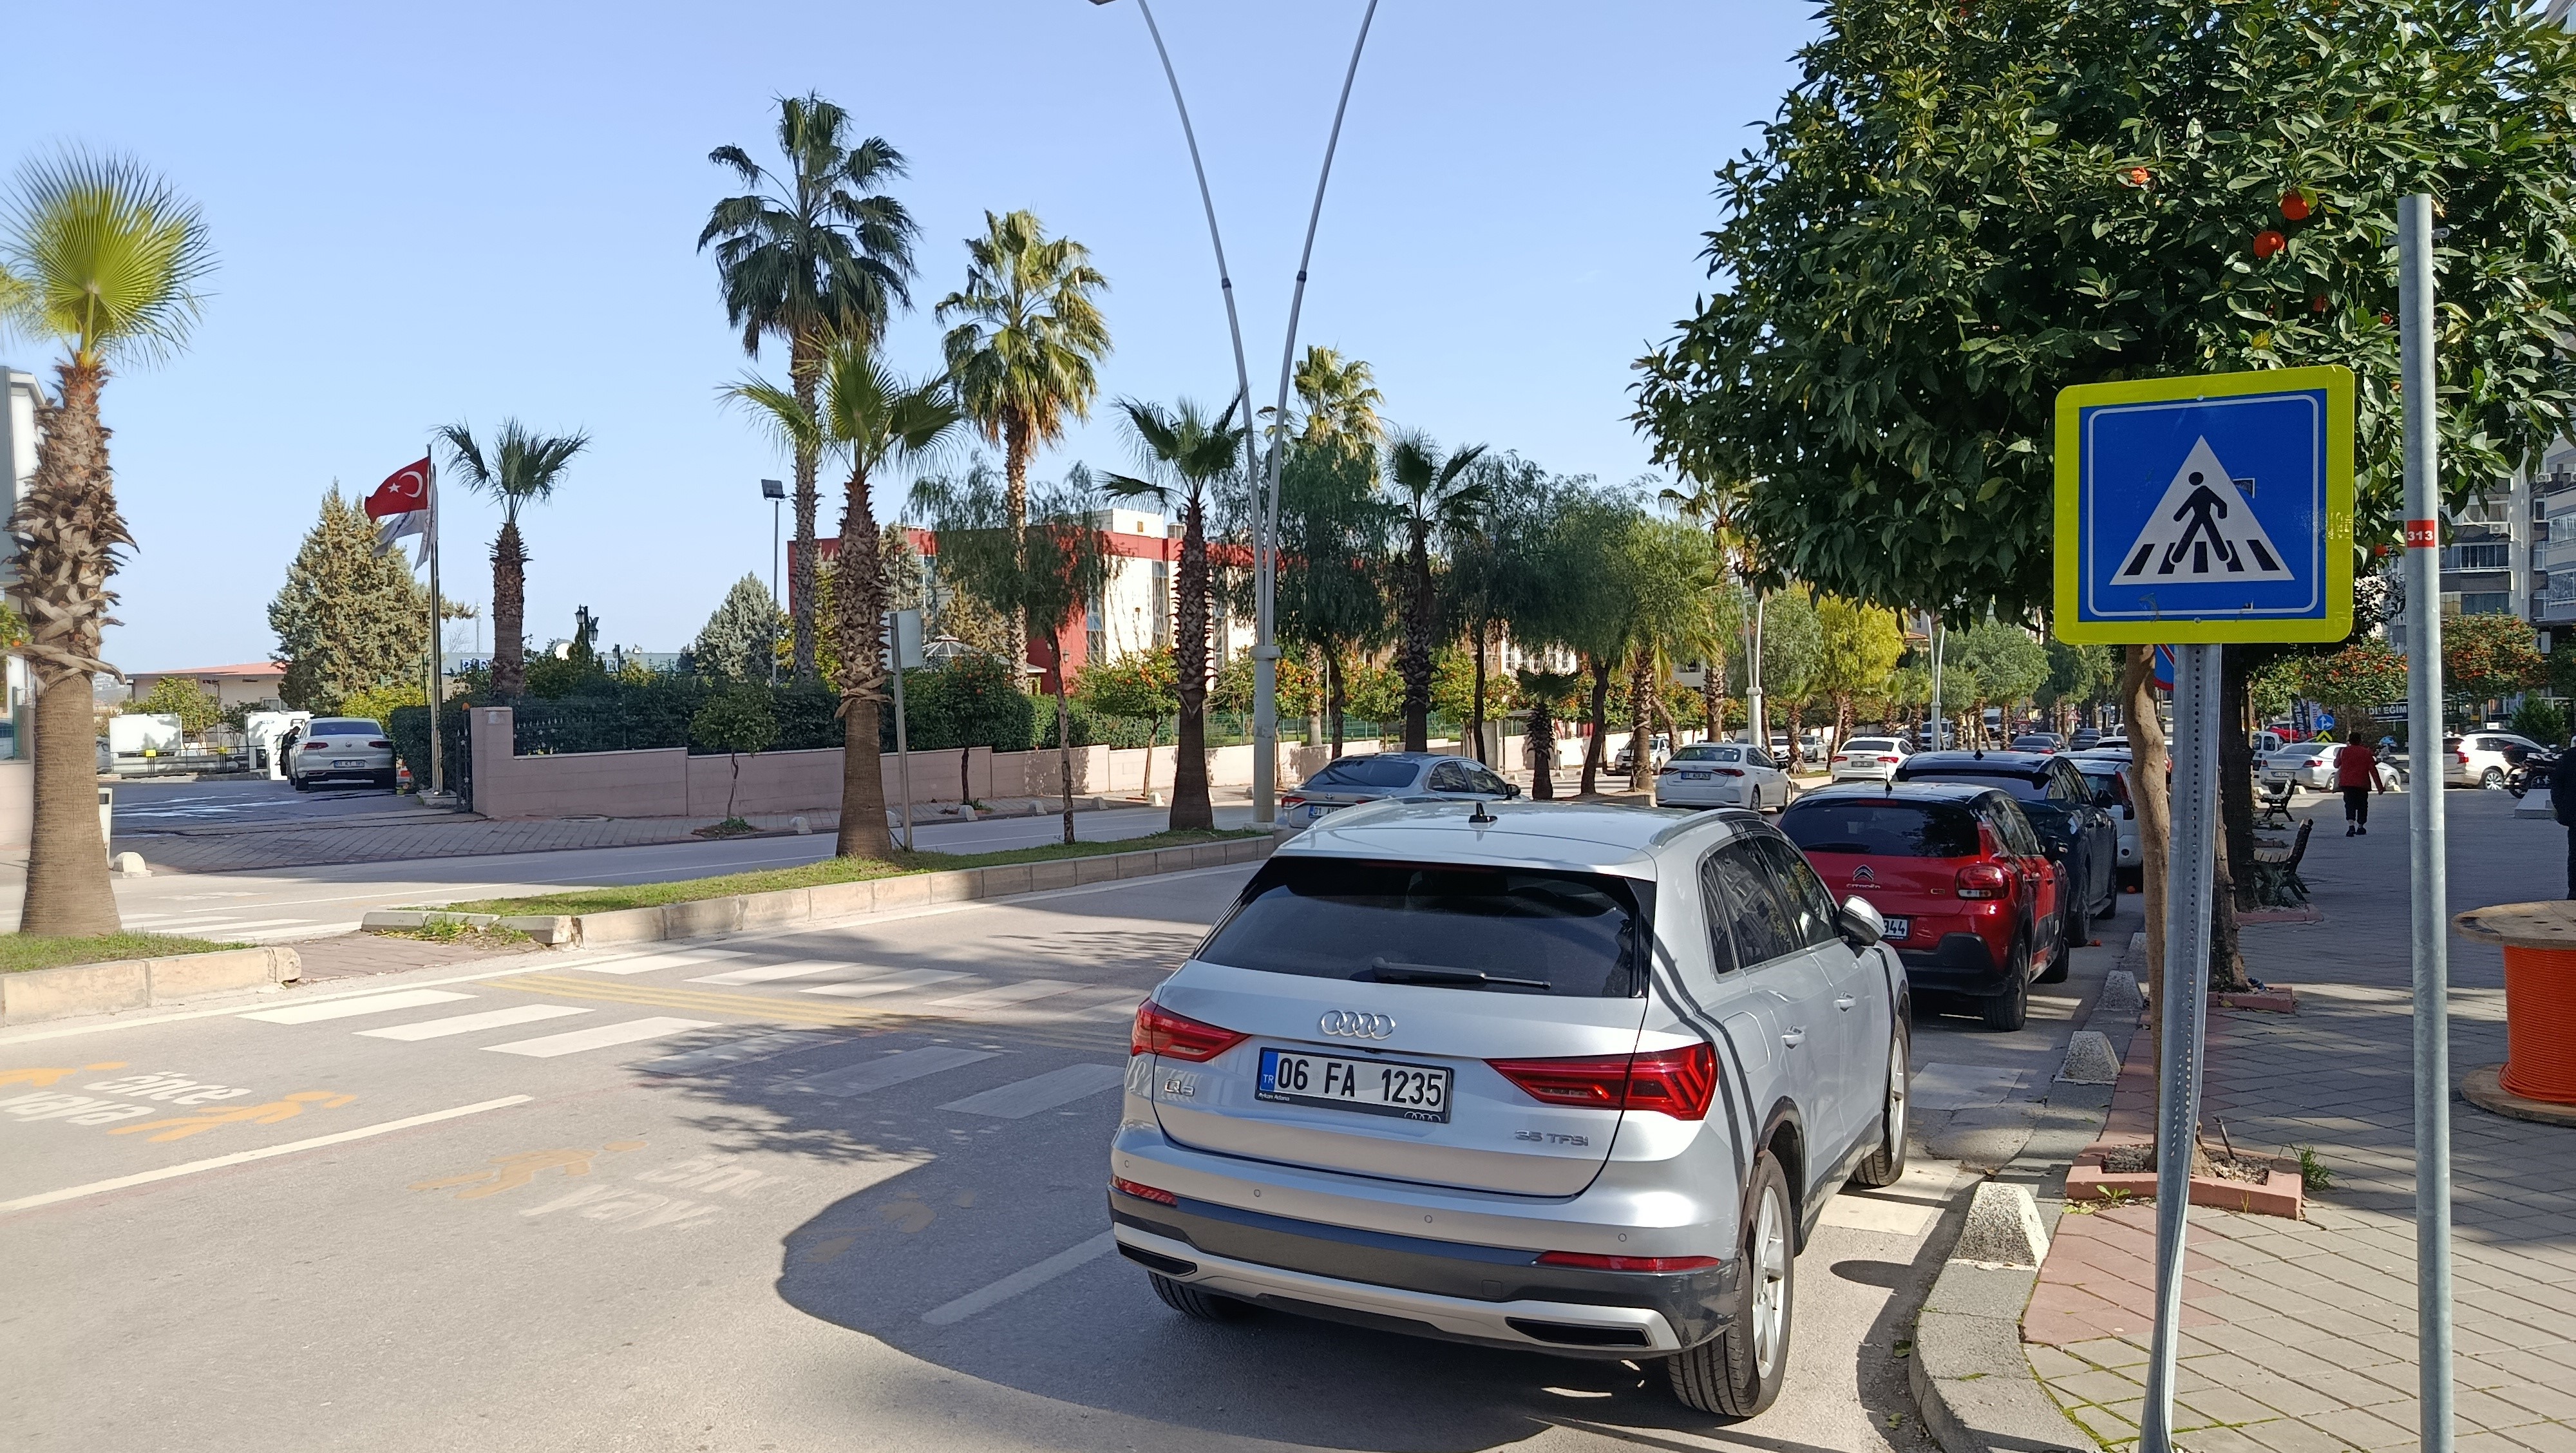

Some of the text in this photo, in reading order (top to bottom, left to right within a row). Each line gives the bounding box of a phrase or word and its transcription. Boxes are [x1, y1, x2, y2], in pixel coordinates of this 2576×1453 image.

[2408, 530, 2434, 541] 313
[1263, 1074, 1274, 1083] TR
[1278, 1058, 1443, 1106] 06 FA 1235
[1164, 1079, 1195, 1097] Q3
[1515, 1130, 1589, 1146] 35 TFSI
